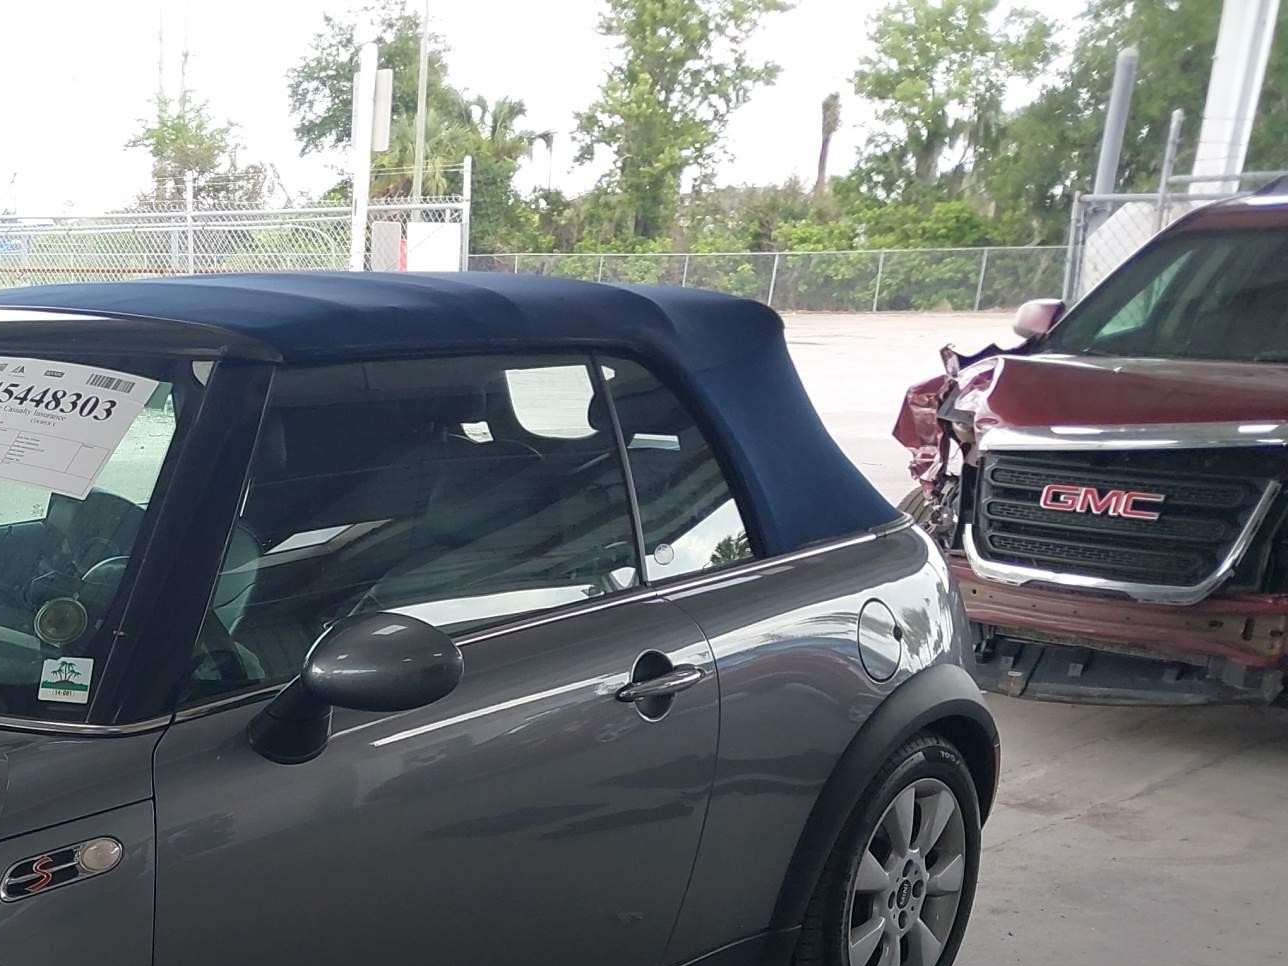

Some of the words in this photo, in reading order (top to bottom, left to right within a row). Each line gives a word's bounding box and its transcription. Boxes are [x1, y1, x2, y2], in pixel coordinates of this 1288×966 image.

[3, 404, 31, 416] Casualty
[33, 409, 67, 421] Insurance
[1040, 484, 1166, 520] GMC
[24, 855, 53, 892] S
